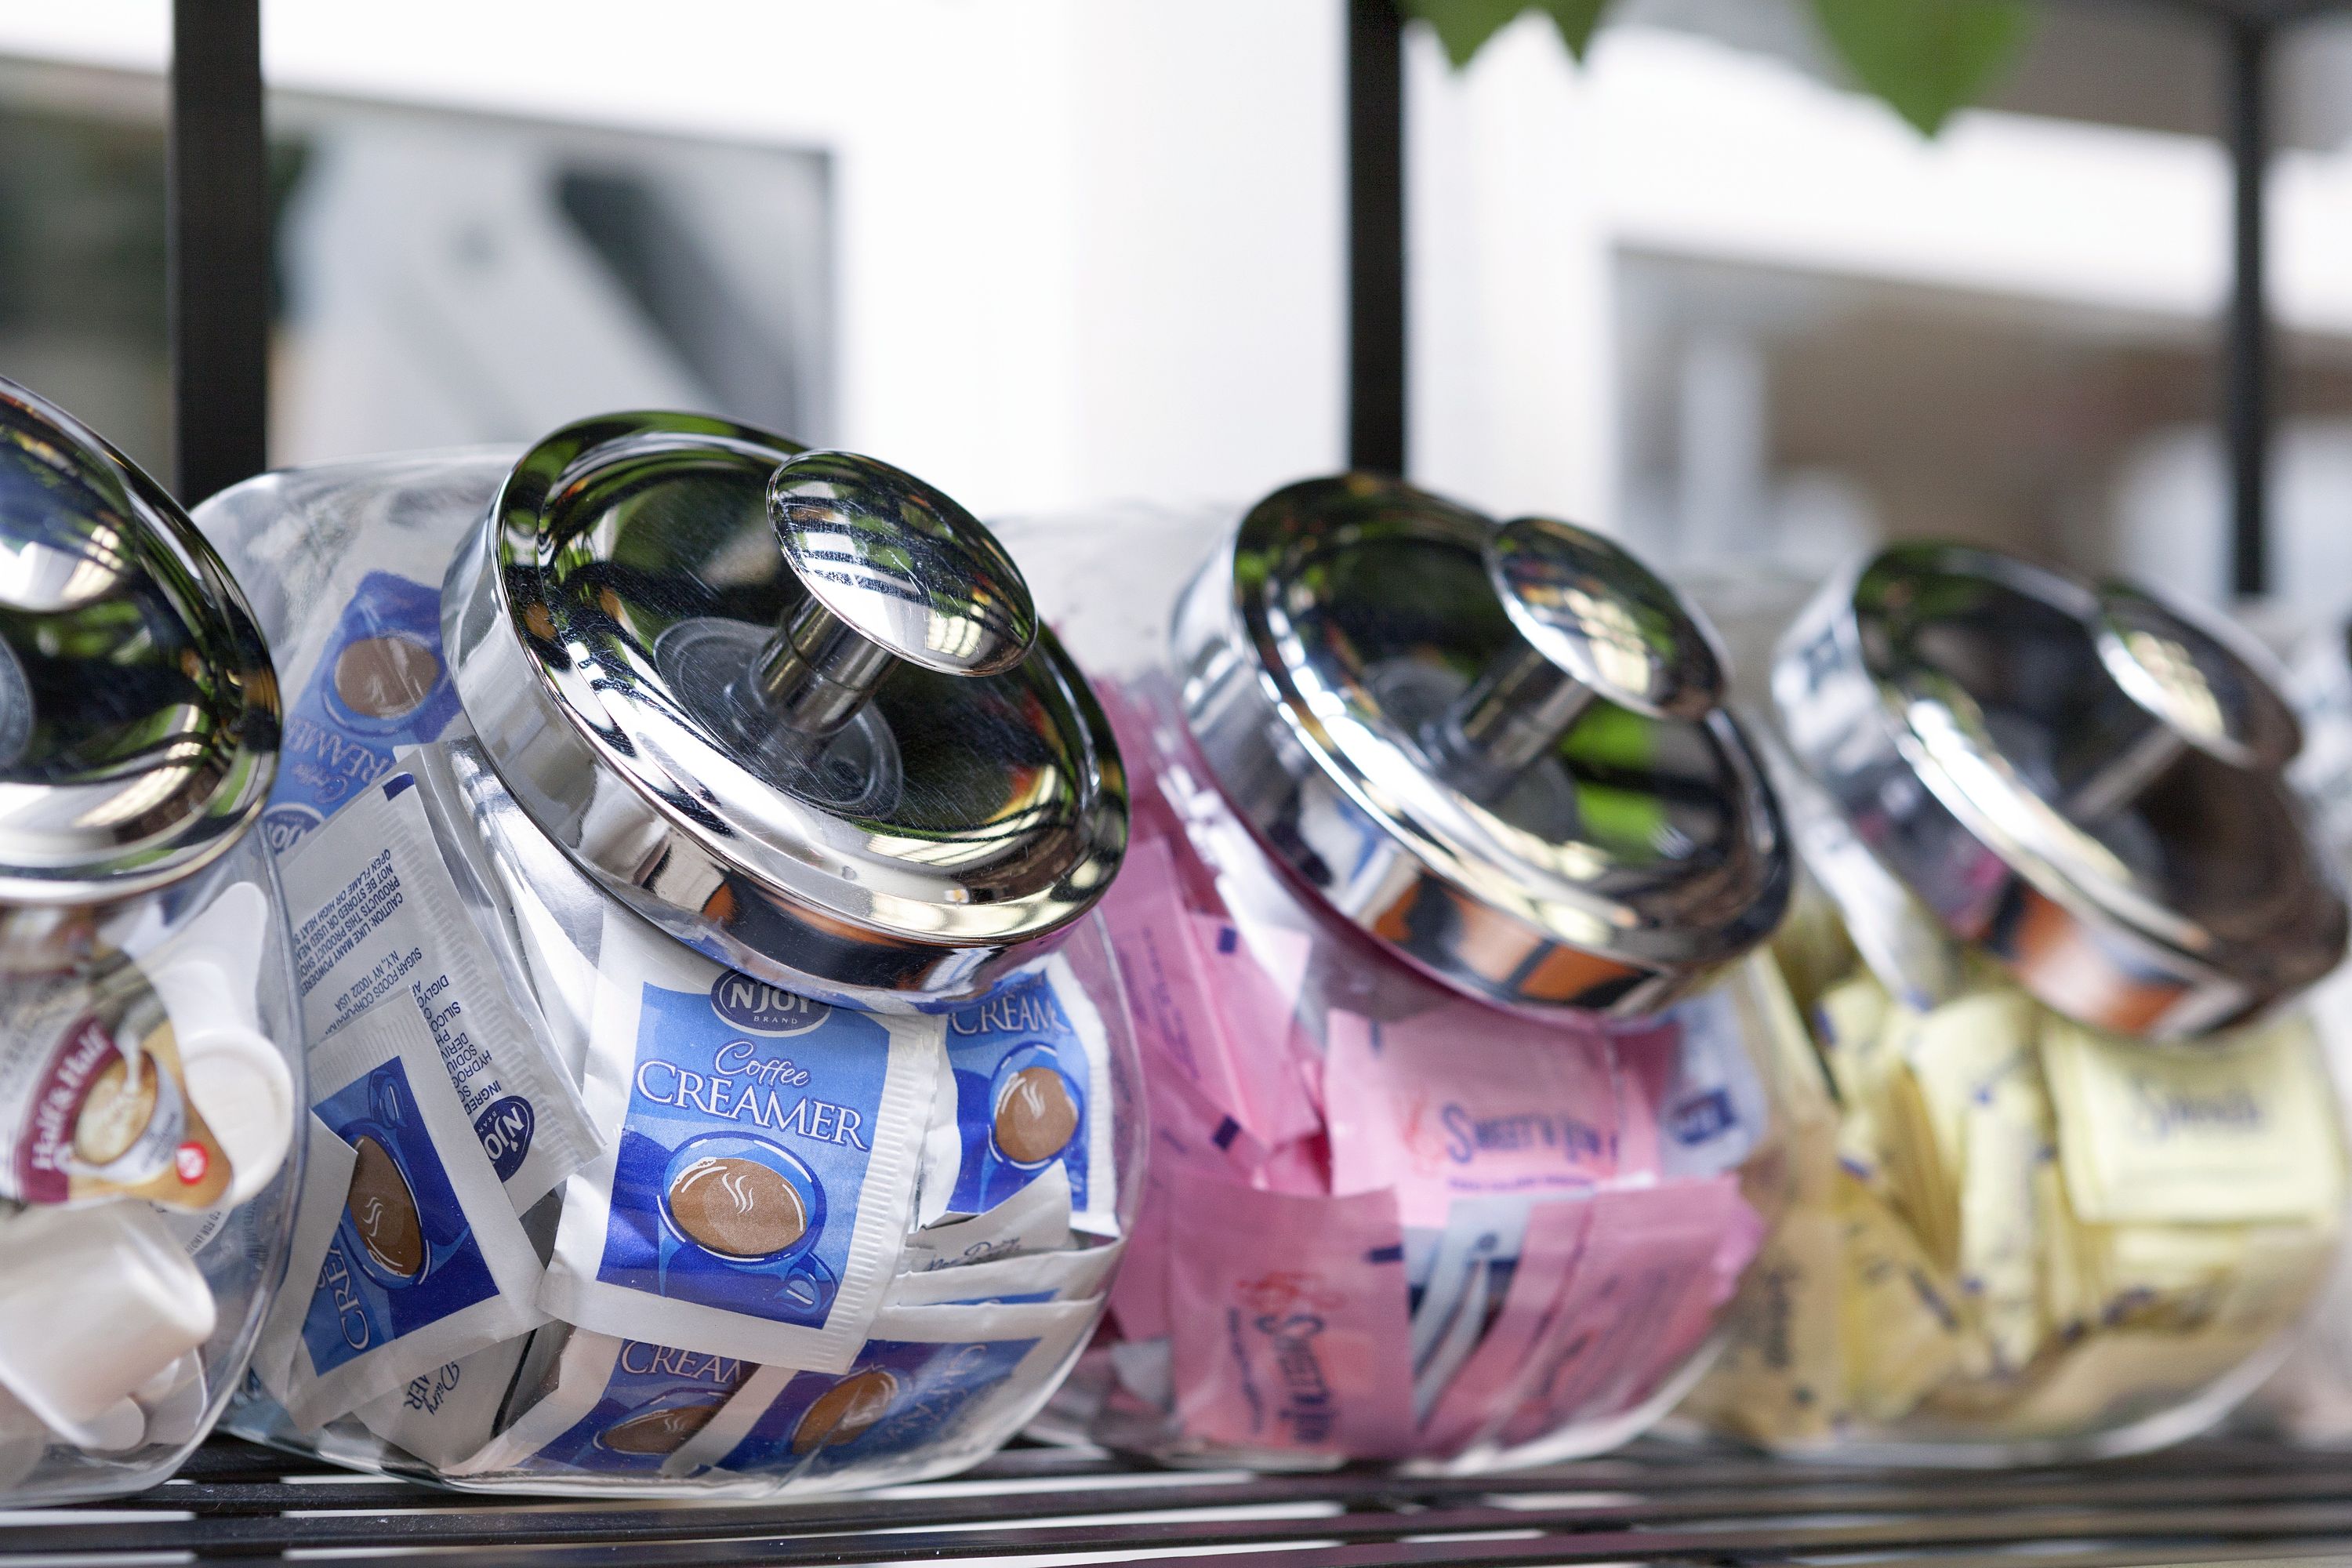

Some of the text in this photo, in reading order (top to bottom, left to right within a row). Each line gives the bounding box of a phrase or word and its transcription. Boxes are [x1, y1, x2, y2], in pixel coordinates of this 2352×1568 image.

[376, 862, 393, 883] NOT
[299, 848, 391, 939] OPEN FLAME OR HIGH HEAT
[360, 875, 400, 917] PRODUCTS
[364, 877, 377, 894] BE
[336, 887, 367, 920] STORED
[367, 891, 404, 928] CAUTION:
[326, 913, 339, 930] OR
[343, 911, 362, 932] THIS
[350, 921, 372, 944] LIKE
[309, 924, 328, 948] USED
[313, 926, 347, 963] PRODUCT
[331, 938, 354, 962] MANY
[395, 946, 422, 976] SUGAR
[370, 964, 384, 981] NY
[372, 969, 400, 998] FOODS
[350, 974, 373, 998] 10022
[333, 993, 352, 1011] USA
[753, 1014, 798, 1025] BRAND
[714, 1041, 811, 1087] Coffee
[637, 1061, 868, 1150] CREAMER
